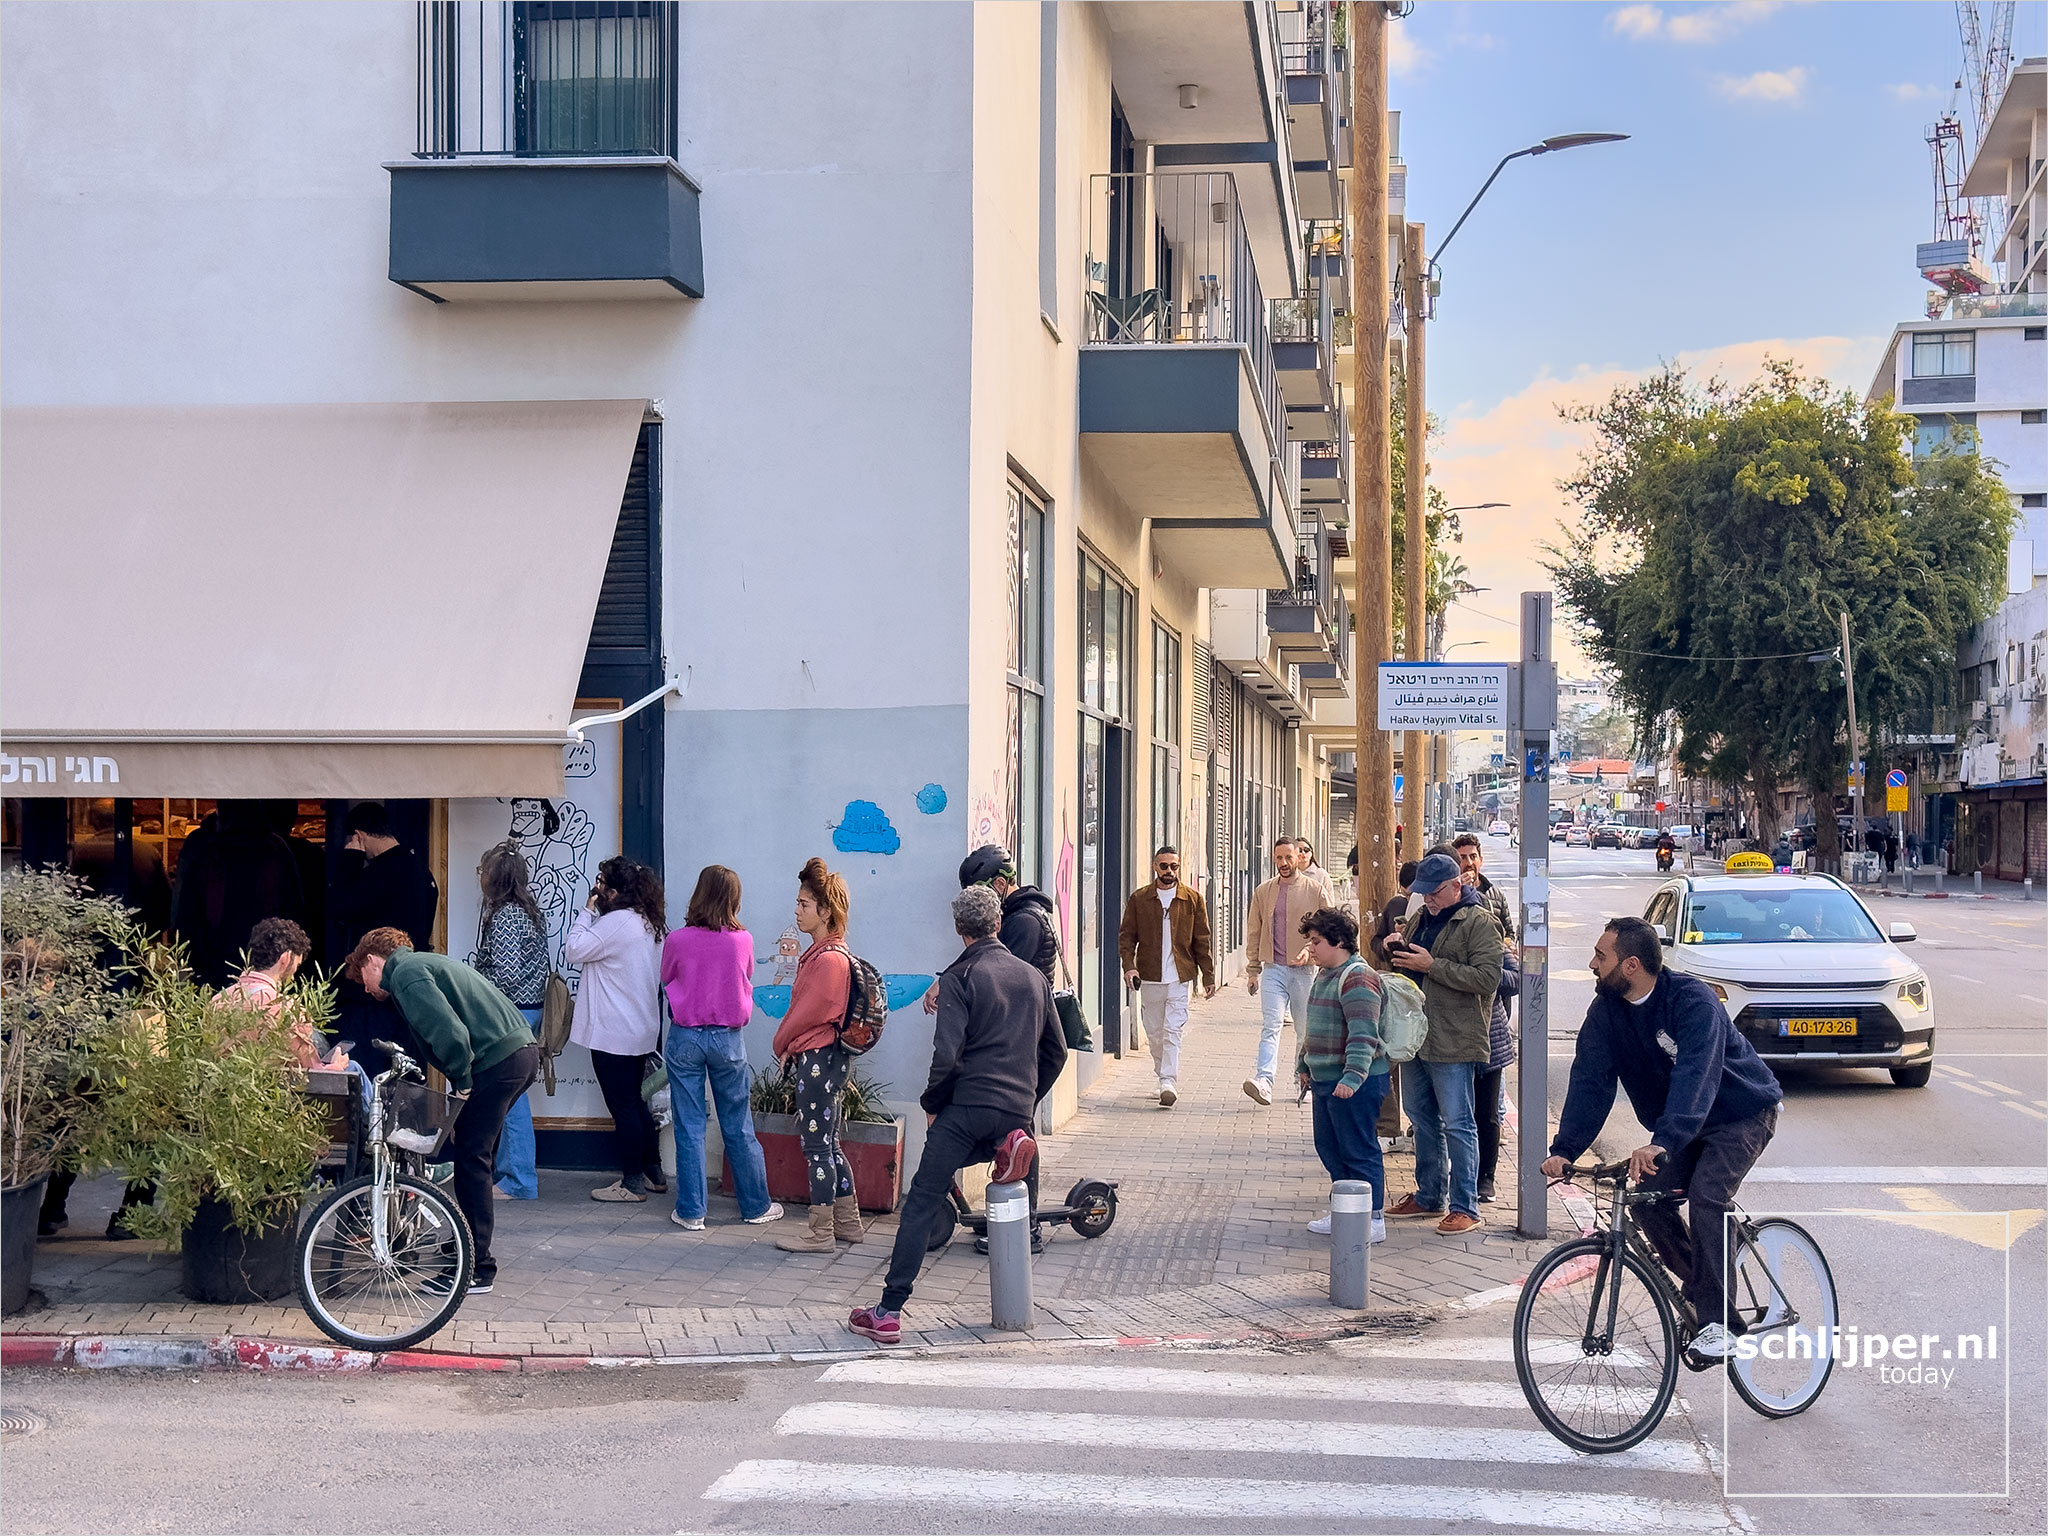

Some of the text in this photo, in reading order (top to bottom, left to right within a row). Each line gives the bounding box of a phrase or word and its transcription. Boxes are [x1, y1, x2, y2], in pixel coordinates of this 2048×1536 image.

[1386, 672, 1426, 685] ויטאל
[1430, 676, 1454, 685] חיים
[1457, 676, 1479, 685] הרב
[1477, 692, 1499, 706] شارع
[1390, 715, 1420, 724] HaRav
[1459, 713, 1483, 724] Vital
[1486, 715, 1498, 724] St.
[65, 756, 120, 783] חגי
